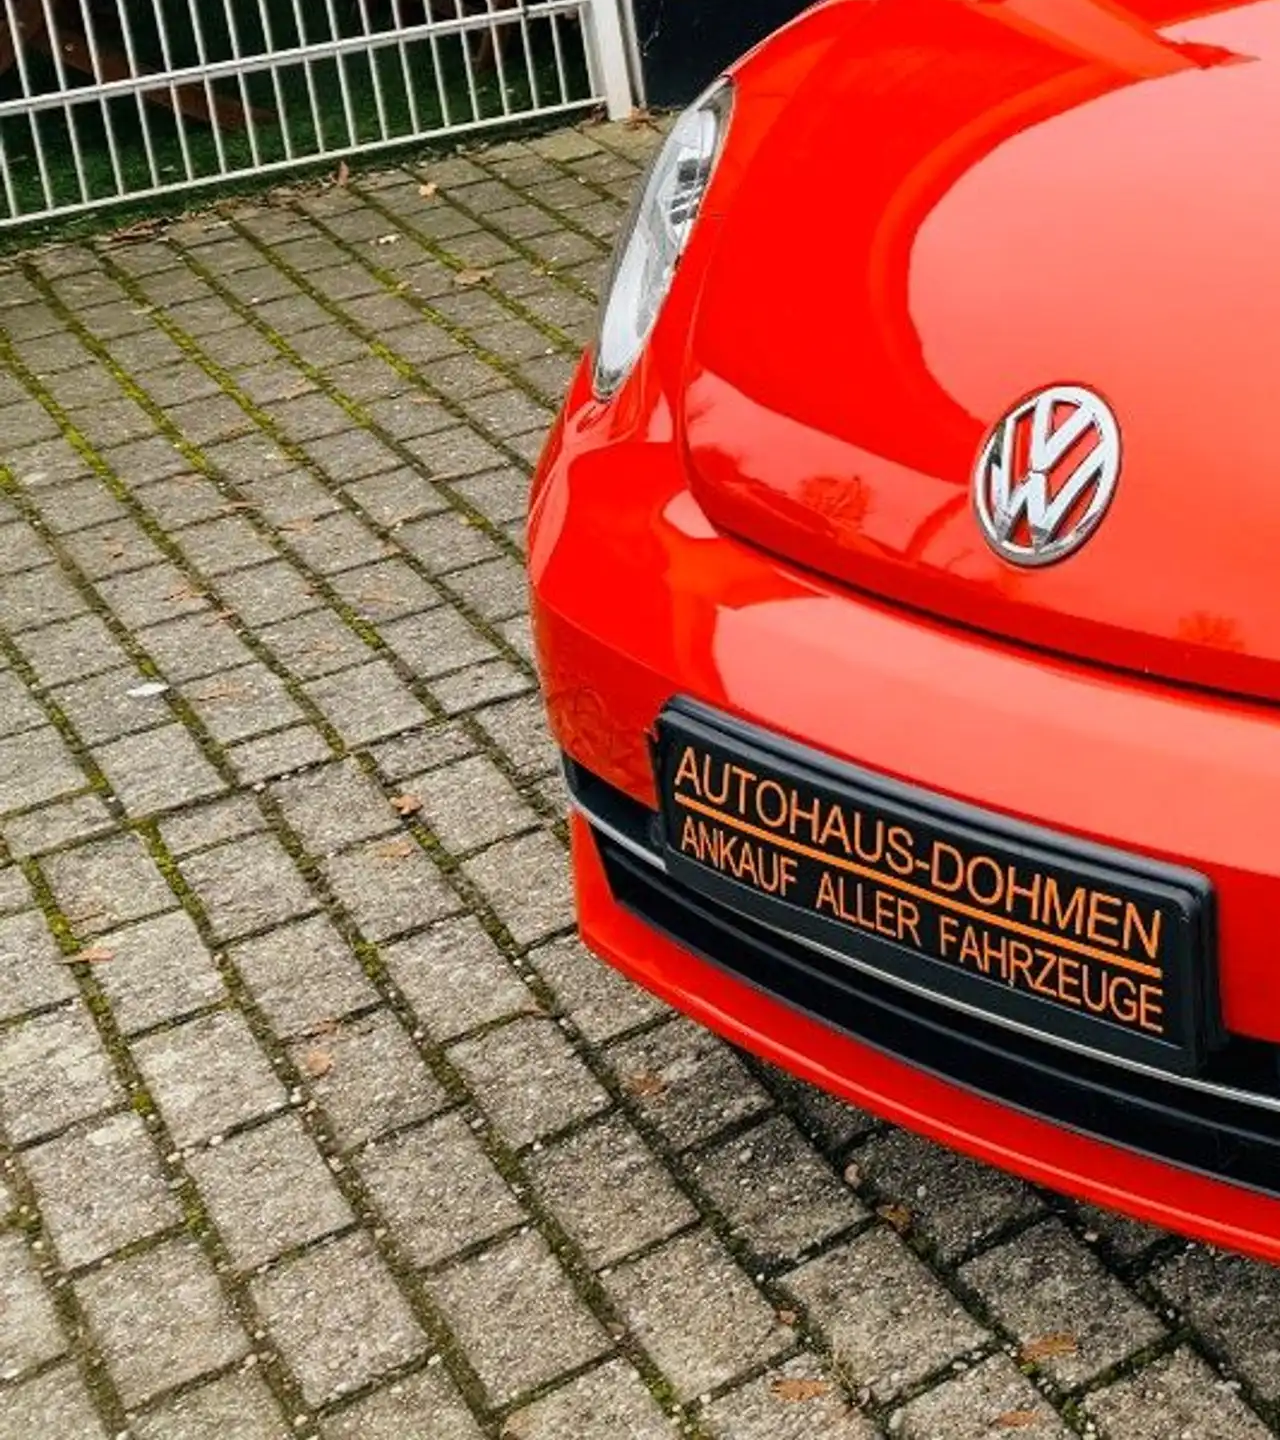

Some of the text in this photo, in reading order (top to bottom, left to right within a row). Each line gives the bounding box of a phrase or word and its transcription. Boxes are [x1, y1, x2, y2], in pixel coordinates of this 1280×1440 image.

[973, 381, 1122, 568] VW
[674, 745, 1163, 961] AUTOHAUS-DOHMEN
[680, 814, 1164, 1035] ANKAUF ALLER FAHRZEUGE
